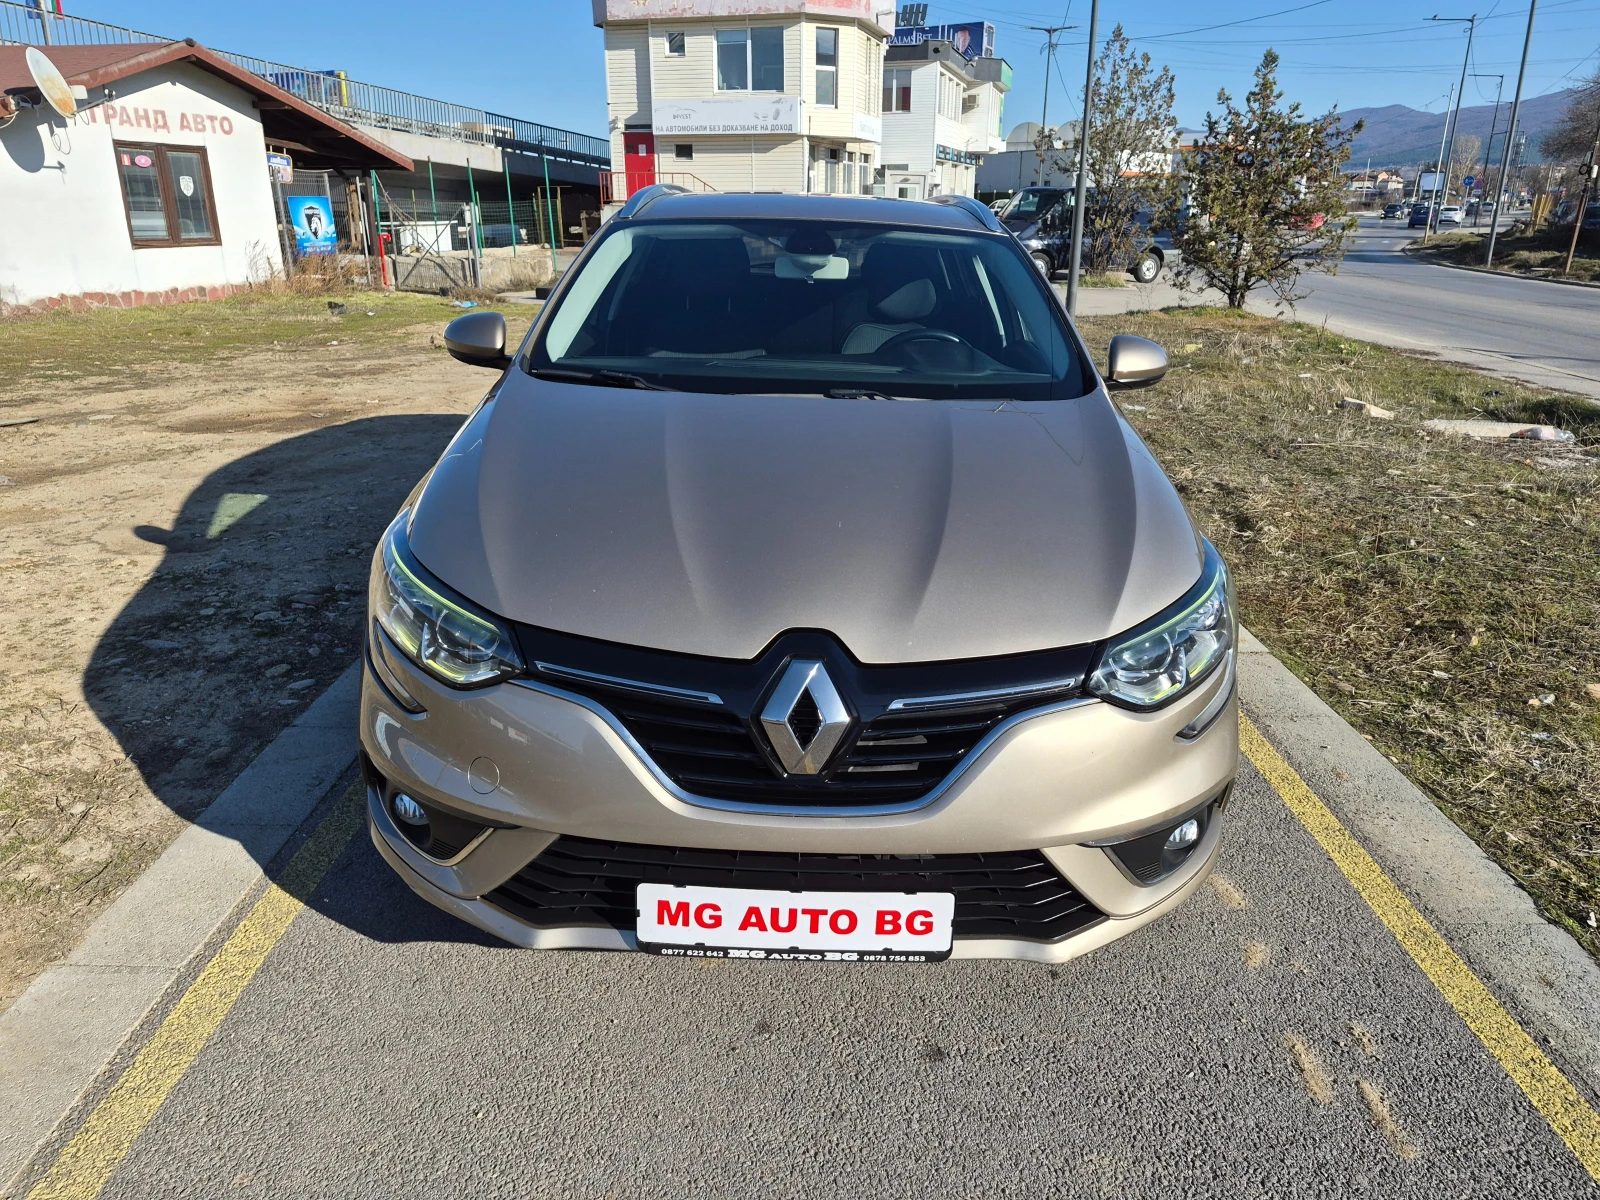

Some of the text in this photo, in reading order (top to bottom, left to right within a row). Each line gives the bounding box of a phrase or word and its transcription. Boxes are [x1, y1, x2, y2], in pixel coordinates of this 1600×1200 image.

[889, 35, 914, 44] PALMS
[89, 103, 234, 136] ГРАНД АВТО
[709, 124, 721, 132] БЕЗ
[722, 124, 758, 132] ДОКАЗВАНЕ
[770, 123, 793, 132] ДОХОД
[657, 899, 934, 936] MG AUTO BG
[686, 949, 704, 957] 622
[706, 950, 724, 958] 642
[727, 949, 767, 959] MG
[823, 952, 860, 960] BG
[889, 954, 907, 962] 756
